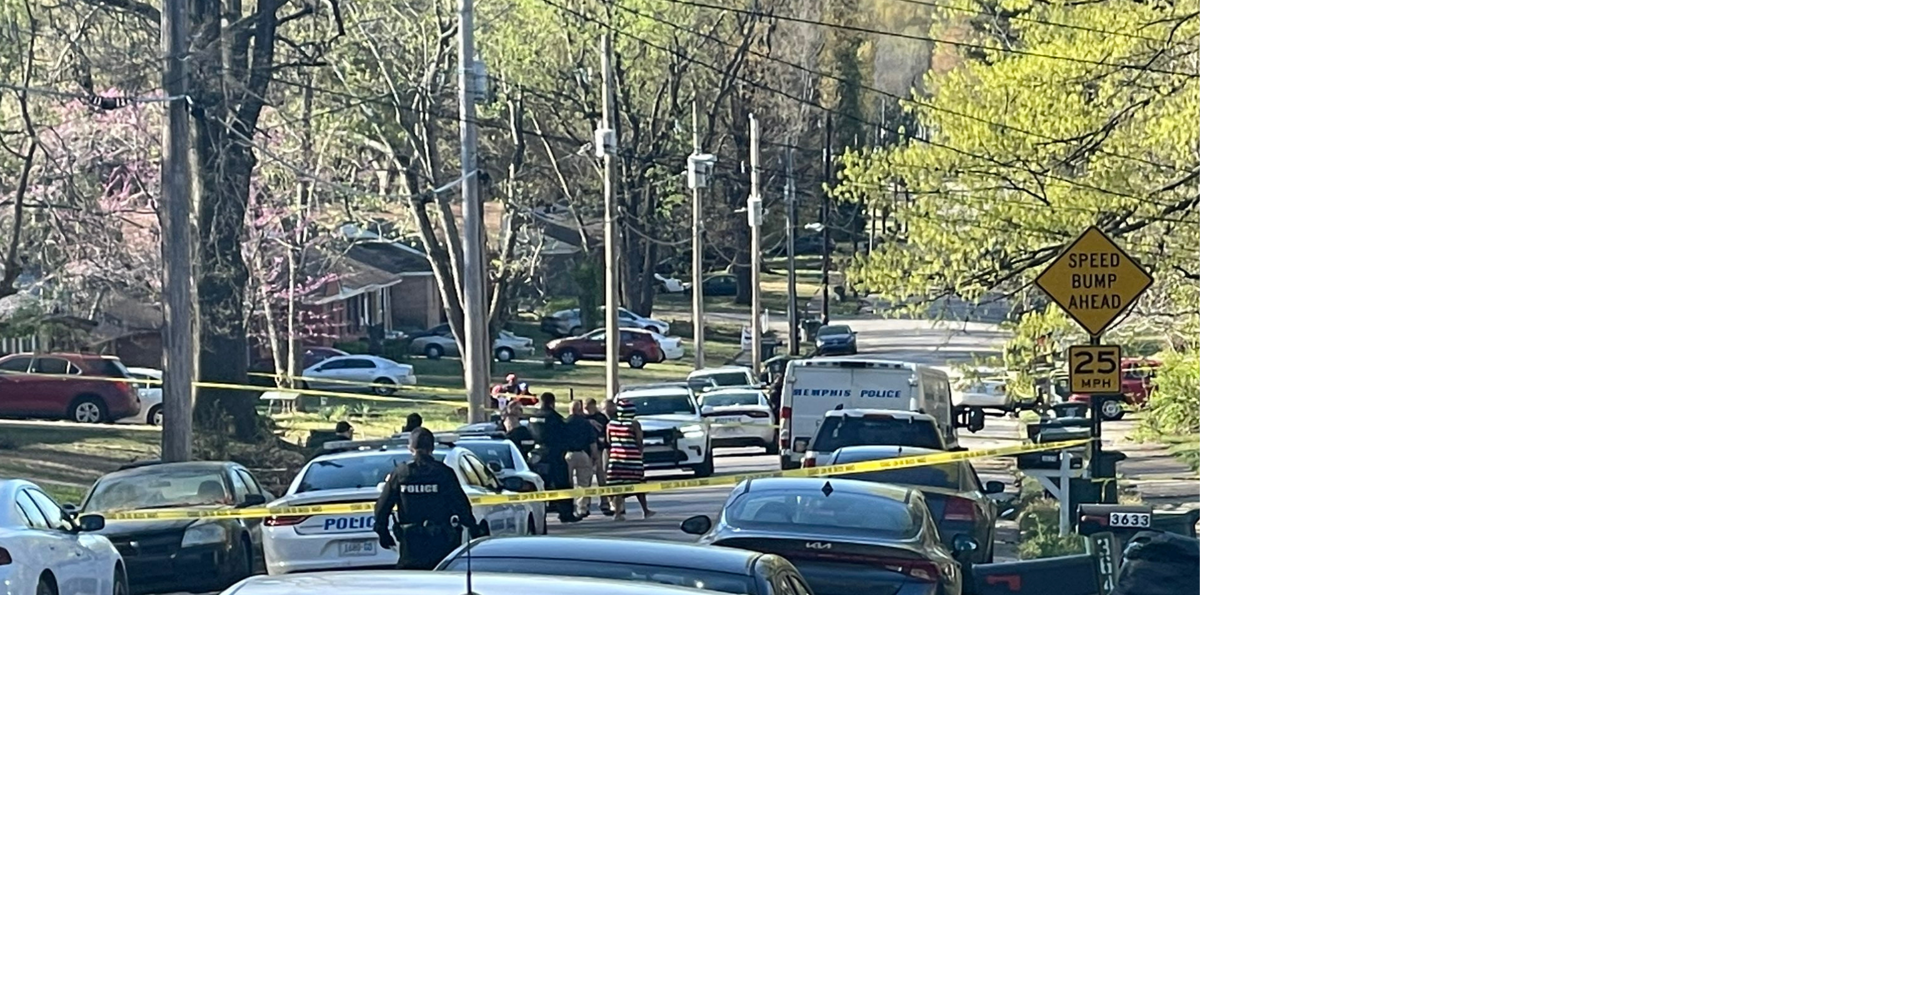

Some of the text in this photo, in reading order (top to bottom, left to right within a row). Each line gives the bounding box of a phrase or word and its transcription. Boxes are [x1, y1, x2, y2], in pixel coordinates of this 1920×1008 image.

[1068, 253, 1120, 268] SPEED
[1072, 274, 1117, 289] BUMP
[1068, 294, 1121, 309] AHEAD
[1074, 351, 1116, 374] 25
[1081, 379, 1111, 388] MPH
[792, 389, 901, 398] MEMPHIS POLICE
[400, 484, 438, 493] POLICE
[323, 516, 375, 530] POLIC
[1111, 513, 1149, 526] 3633
